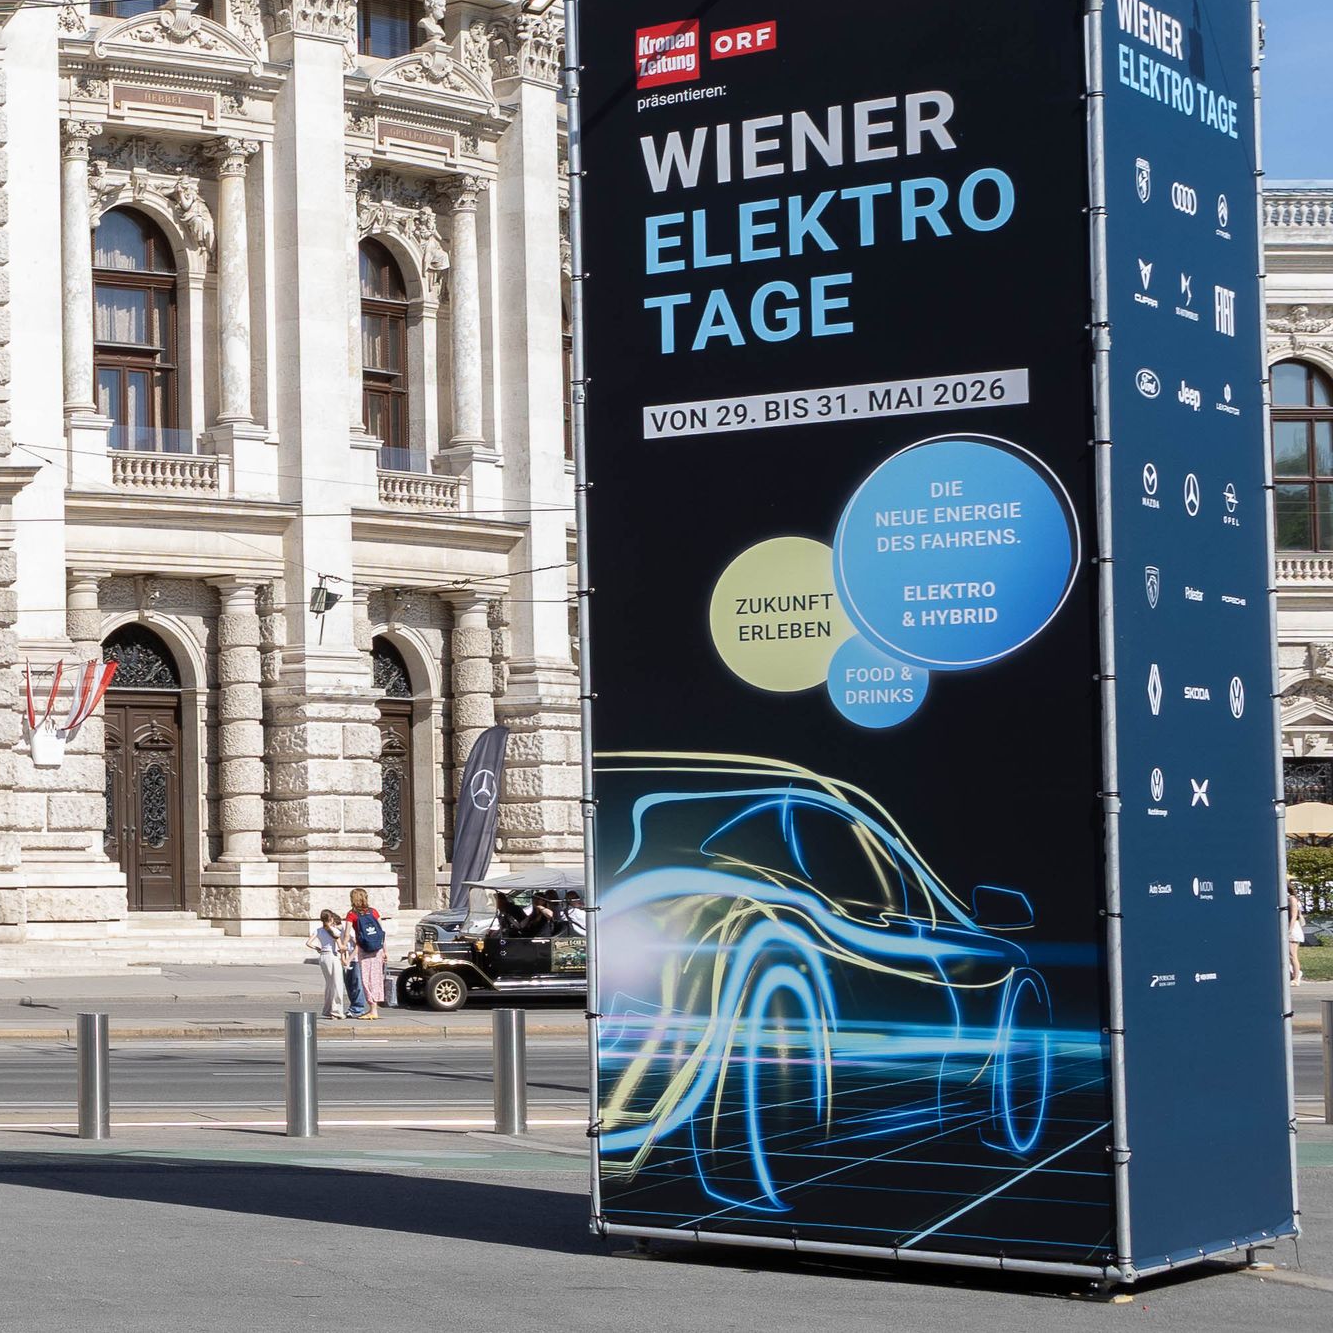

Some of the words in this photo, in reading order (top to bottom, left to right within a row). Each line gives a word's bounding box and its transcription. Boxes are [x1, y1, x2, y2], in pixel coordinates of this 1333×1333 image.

[638, 31, 695, 56] Kronen
[714, 27, 771, 53] ORF
[638, 53, 695, 77] Zeitung
[144, 92, 184, 105] HEBBEL
[637, 85, 726, 112] präsentieren:
[1118, 43, 1194, 116] ELEKTRO
[1196, 83, 1238, 139] TAGE
[640, 90, 957, 193] WIENER
[645, 167, 1015, 275] ELEKTRO
[1134, 292, 1159, 308] CUPRA
[1214, 285, 1235, 337] FIAT
[643, 272, 854, 354] TAGE
[1140, 372, 1157, 394] Ford
[650, 407, 708, 433] VON
[716, 403, 757, 428] 29.
[764, 397, 810, 422] BIS
[817, 392, 859, 416] 31.
[868, 385, 923, 411] MAI
[933, 377, 1006, 405] 2026
[1177, 380, 1201, 412] Jeep
[930, 480, 964, 498] DIE
[1142, 497, 1160, 509] MAZDA
[875, 508, 928, 528] NEUE
[933, 502, 1022, 524] ENERGIE
[1223, 515, 1240, 527] OPEL
[876, 534, 915, 553] DES
[920, 528, 1022, 550] FAHRENS.
[903, 581, 996, 602] ELEKTRO
[1184, 586, 1204, 602] Polestar
[1221, 595, 1246, 606] PORSCHE
[735, 593, 833, 616] ZUKUNFT
[902, 611, 915, 627] &
[920, 607, 998, 627] HYBRID
[738, 620, 831, 643] ERLEBEN
[845, 667, 895, 683] FOOD
[900, 666, 913, 682] &
[845, 687, 914, 705] DRINKS
